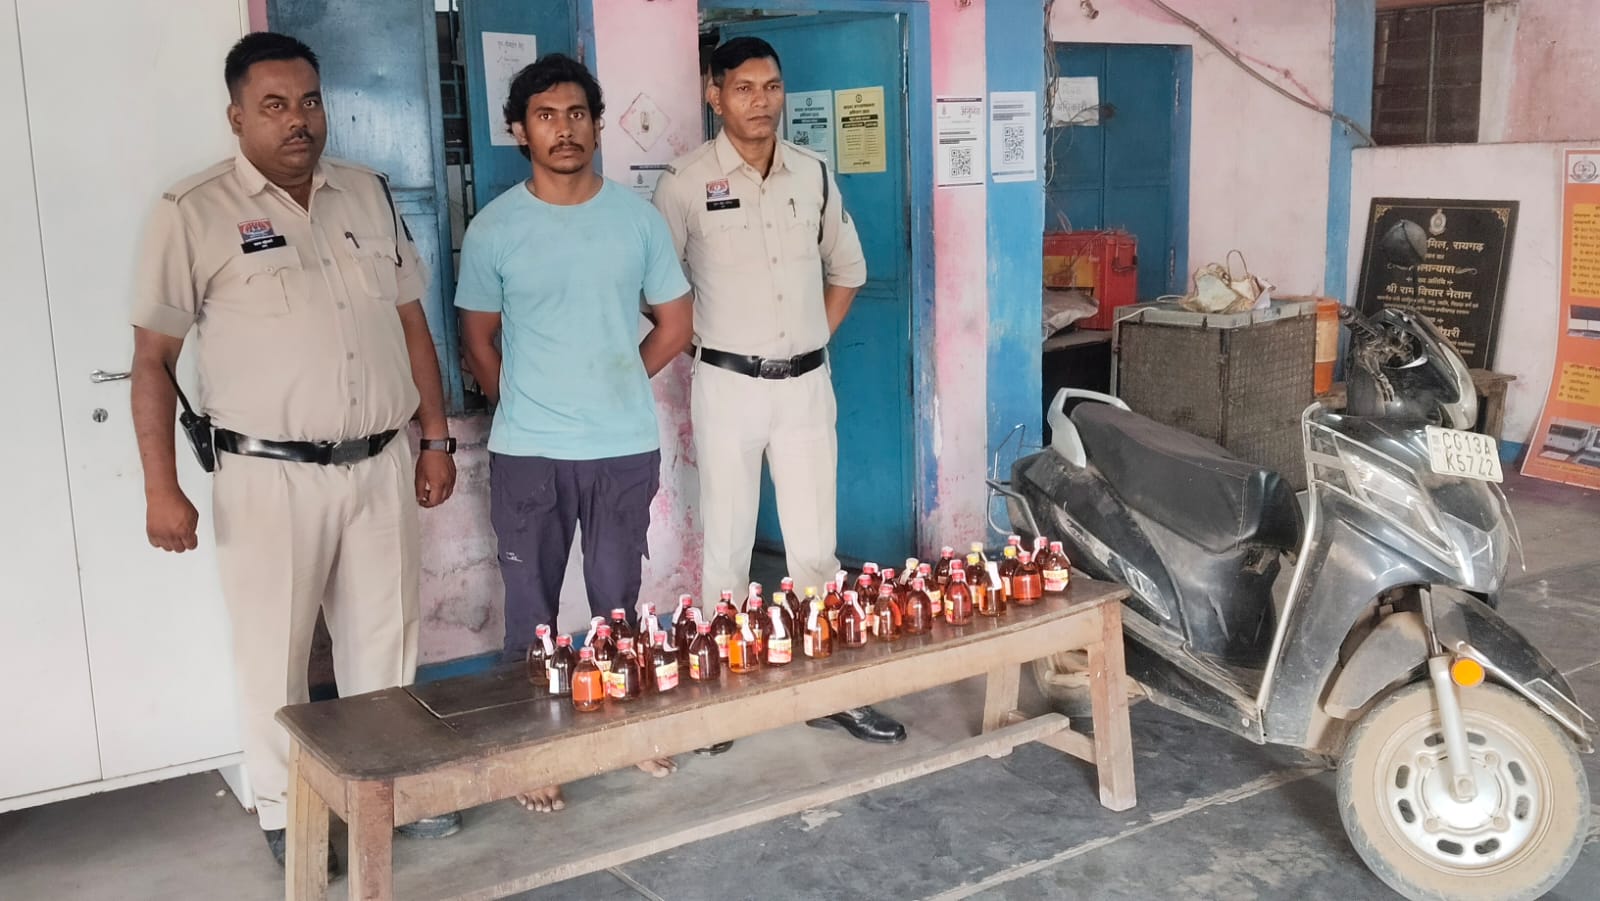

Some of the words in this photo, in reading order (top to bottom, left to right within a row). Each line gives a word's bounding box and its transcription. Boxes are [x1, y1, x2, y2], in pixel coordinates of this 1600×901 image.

[1452, 241, 1485, 253] रायगढ़
[1386, 283, 1397, 294] श्री
[1400, 286, 1414, 295] राम
[1418, 285, 1443, 297] विचार
[1446, 287, 1472, 300] नेताम
[1442, 432, 1491, 456] CG13A
